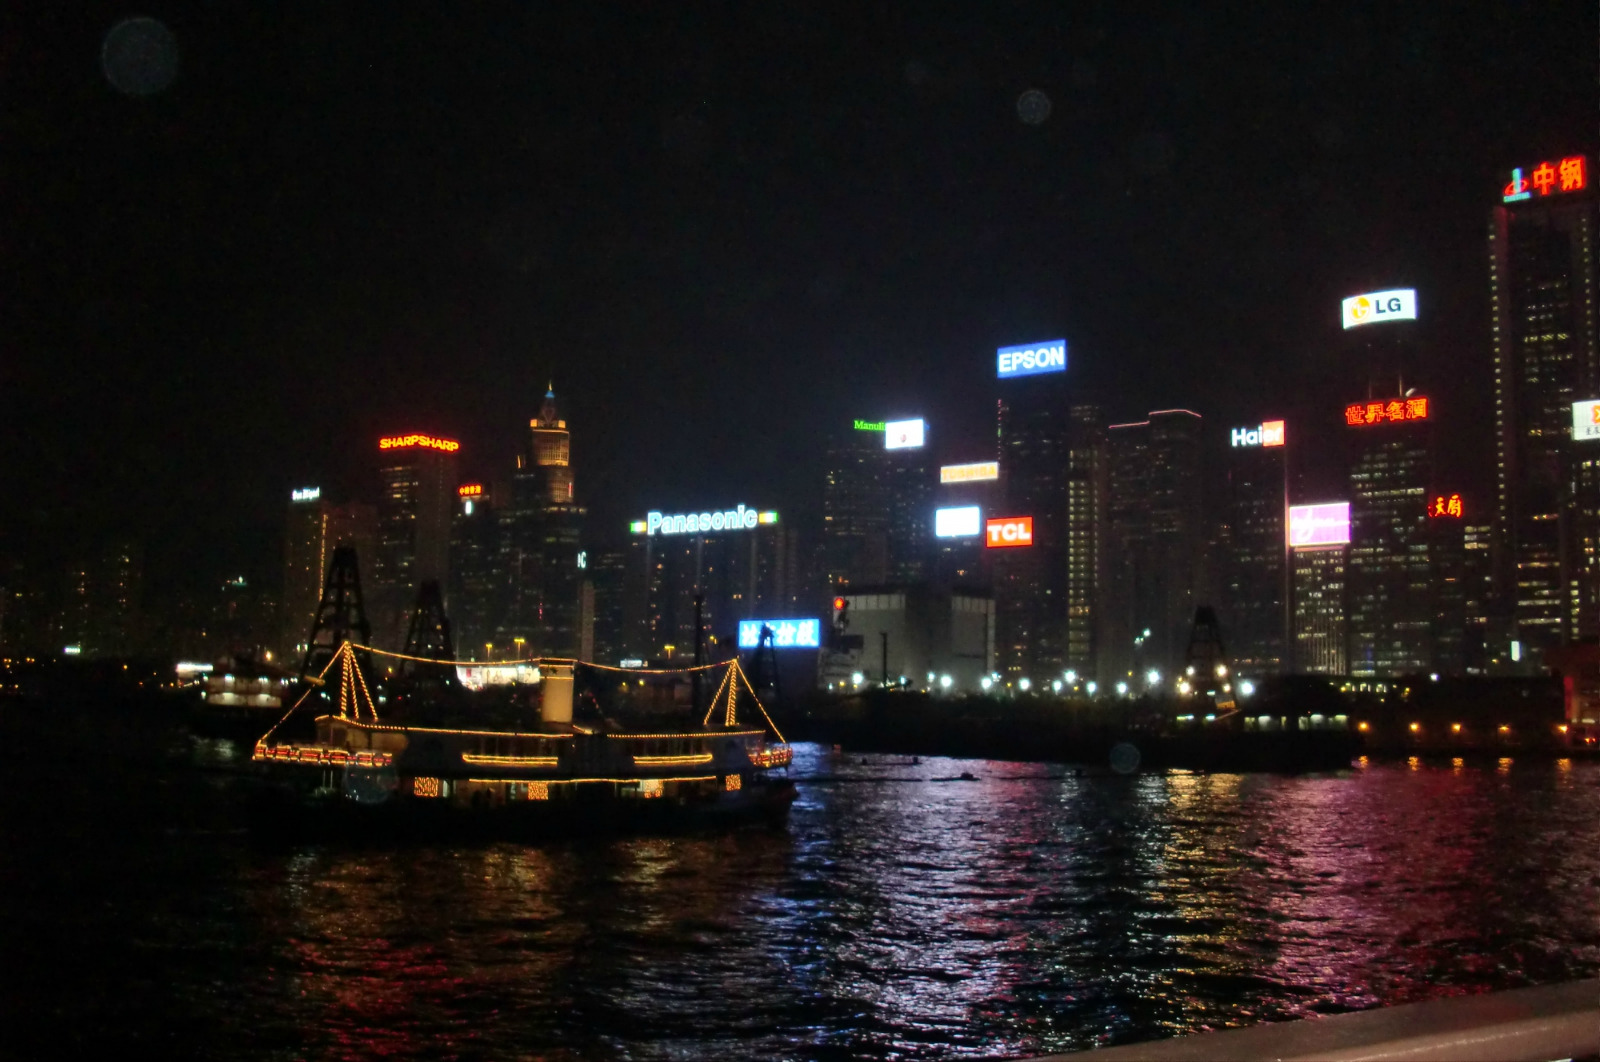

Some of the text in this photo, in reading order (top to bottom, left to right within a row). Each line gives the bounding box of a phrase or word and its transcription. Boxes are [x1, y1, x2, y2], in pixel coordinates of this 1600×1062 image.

[1375, 297, 1401, 314] LG
[999, 346, 1064, 373] EPSON
[1345, 398, 1427, 425] 世界名酒
[379, 435, 419, 449] SHARP
[418, 435, 459, 452] SHARP
[1231, 424, 1282, 447] Haier
[942, 465, 996, 481] TOSHIBA
[647, 504, 758, 535] Panasonic
[987, 523, 1031, 542] TCL
